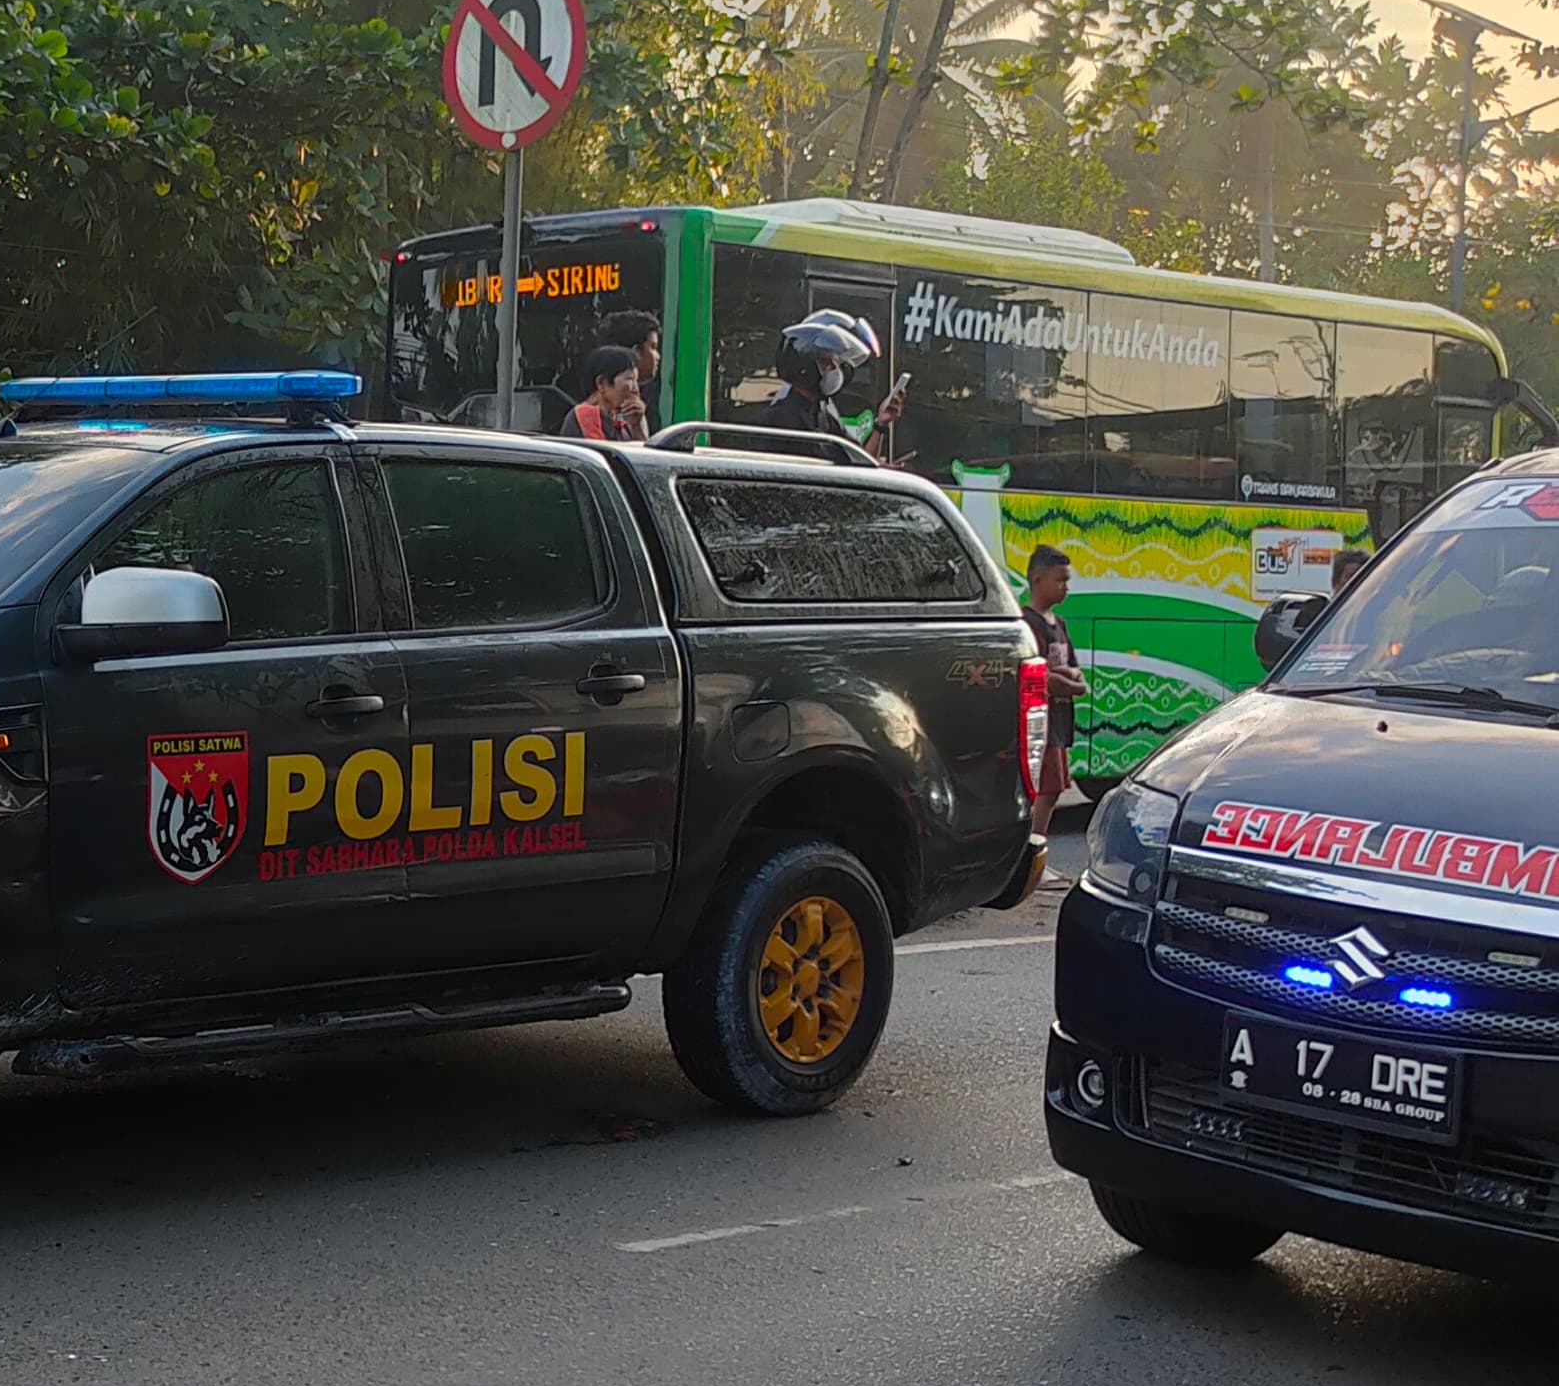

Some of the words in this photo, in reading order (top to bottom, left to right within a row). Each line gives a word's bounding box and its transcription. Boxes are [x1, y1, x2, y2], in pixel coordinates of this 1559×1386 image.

[546, 263, 621, 297] SIRING
[153, 739, 195, 755] POLISI
[198, 737, 243, 752] SATWA
[264, 731, 586, 846] POLISI
[258, 848, 300, 881] DIT
[306, 837, 416, 876] SABHARA
[423, 830, 497, 864] POLDA
[503, 821, 587, 855] KALSEL
[1230, 1028, 1255, 1066] A
[1296, 1039, 1335, 1079] 17
[1371, 1053, 1449, 1103] DRE
[1395, 1102, 1446, 1123] GROUP
